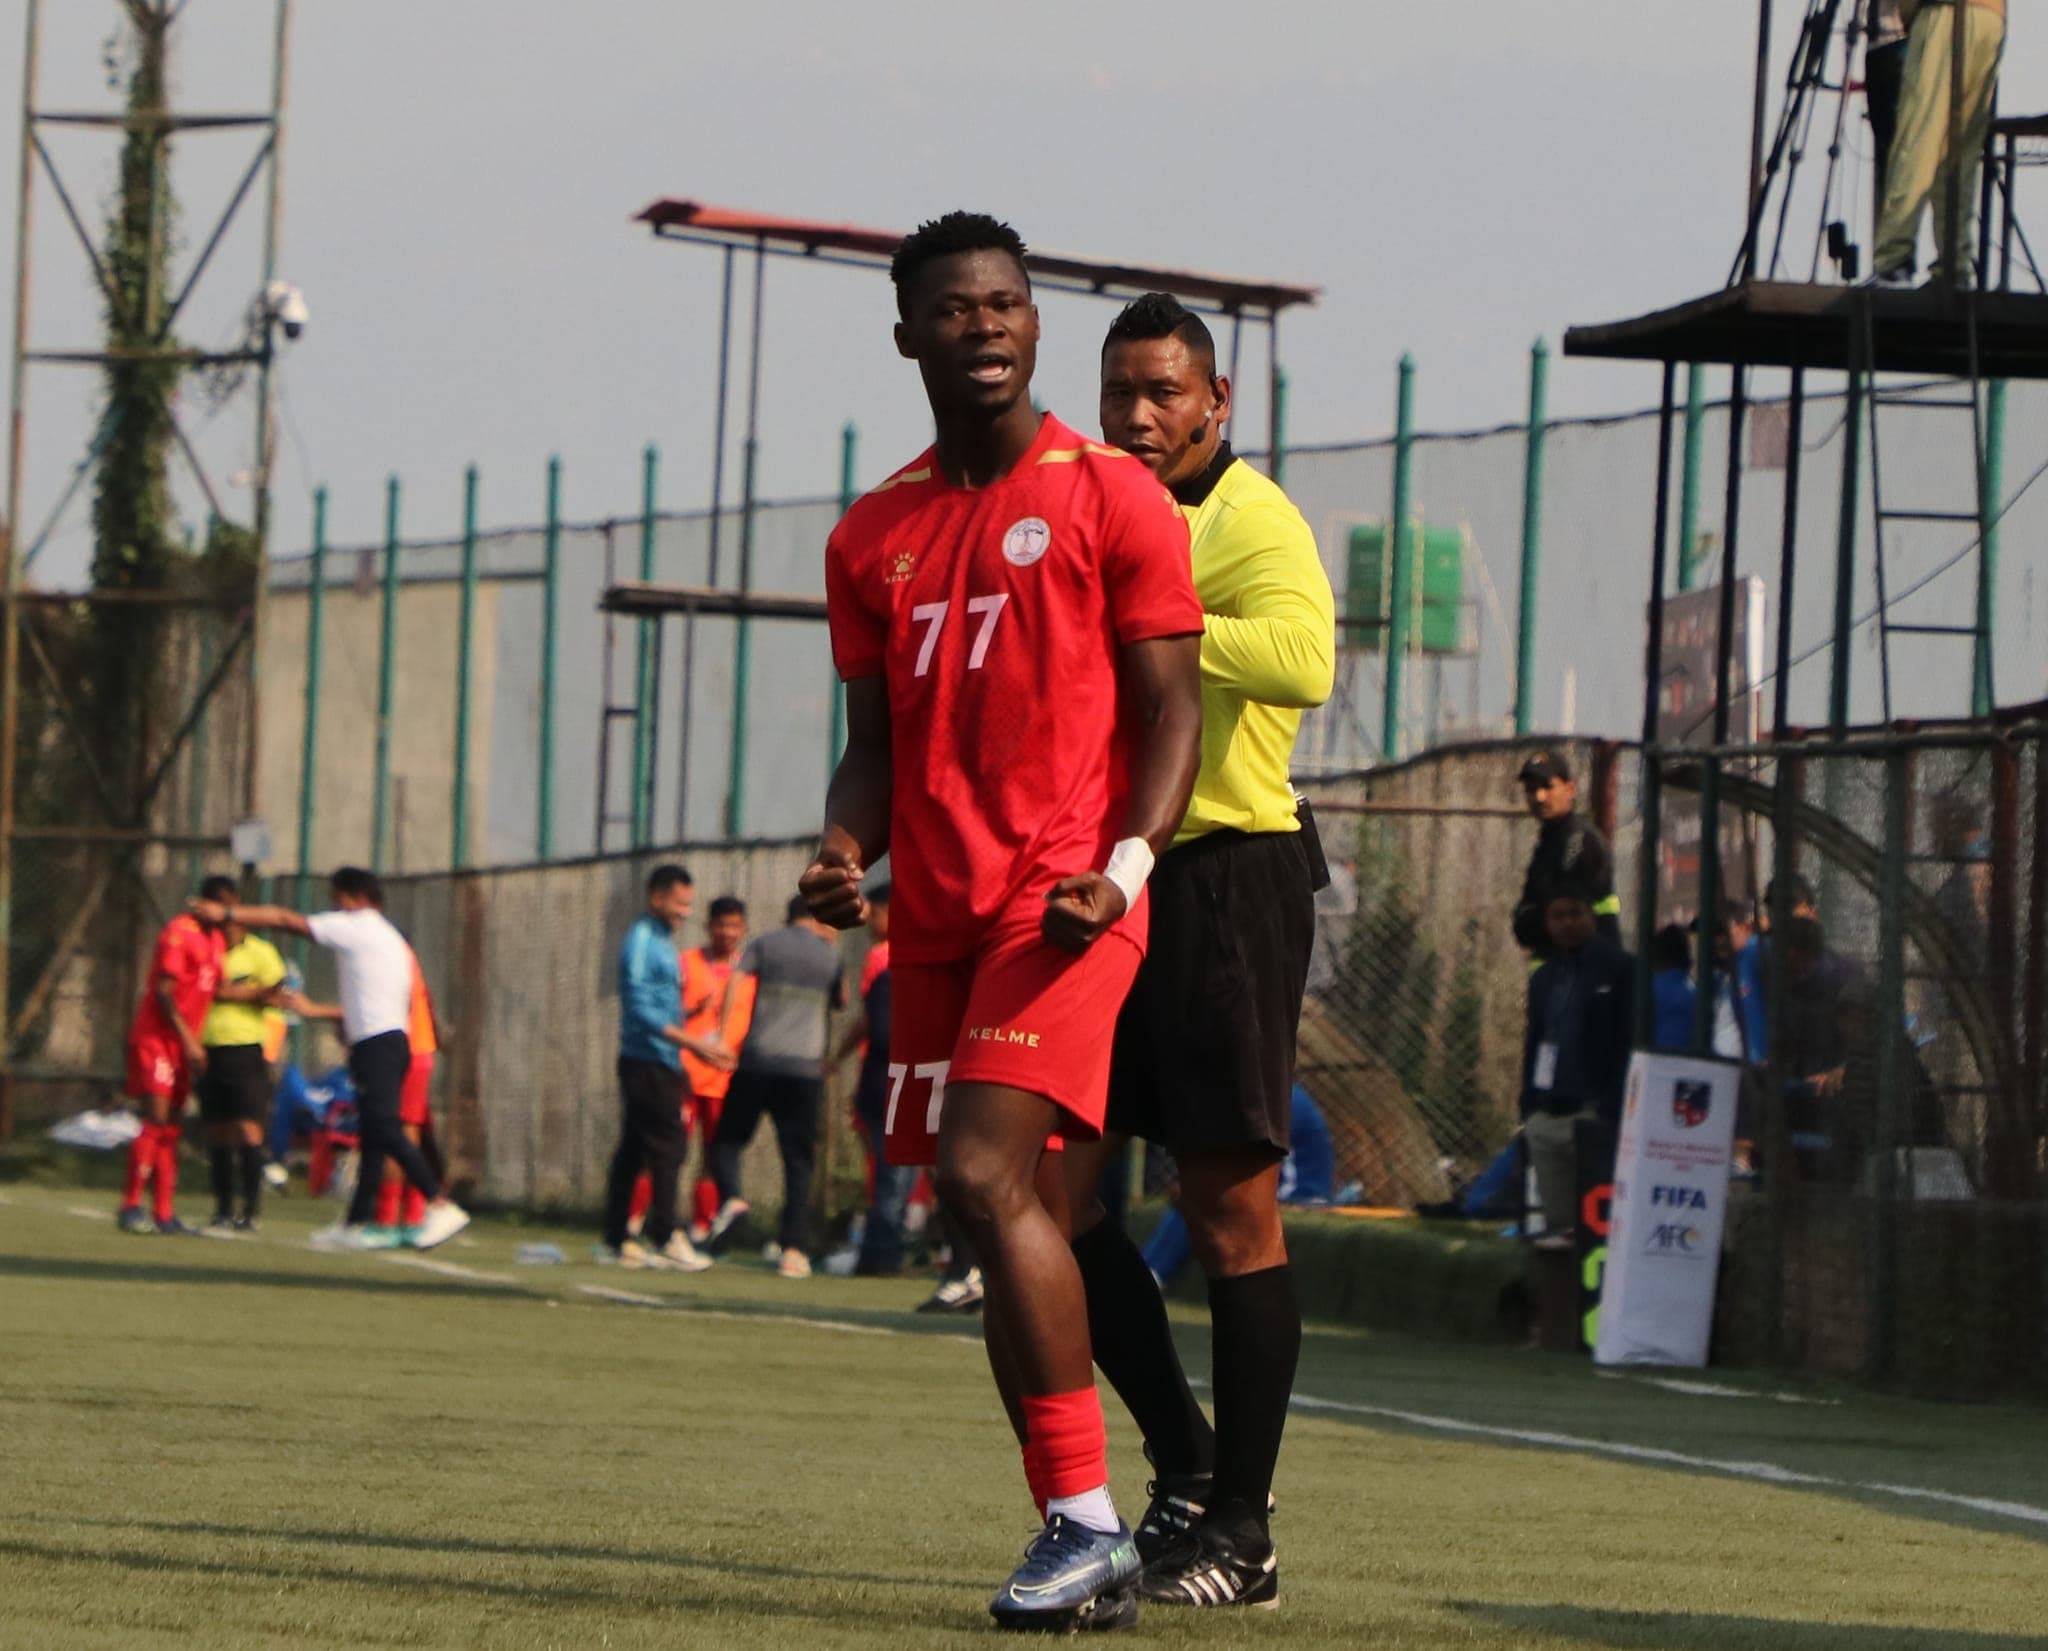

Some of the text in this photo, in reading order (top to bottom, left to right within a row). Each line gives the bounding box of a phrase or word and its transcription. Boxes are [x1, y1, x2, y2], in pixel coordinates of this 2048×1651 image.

[912, 593, 1009, 678] 77
[969, 1028, 1041, 1048] KELME
[1652, 1185, 1706, 1209] FIFA
